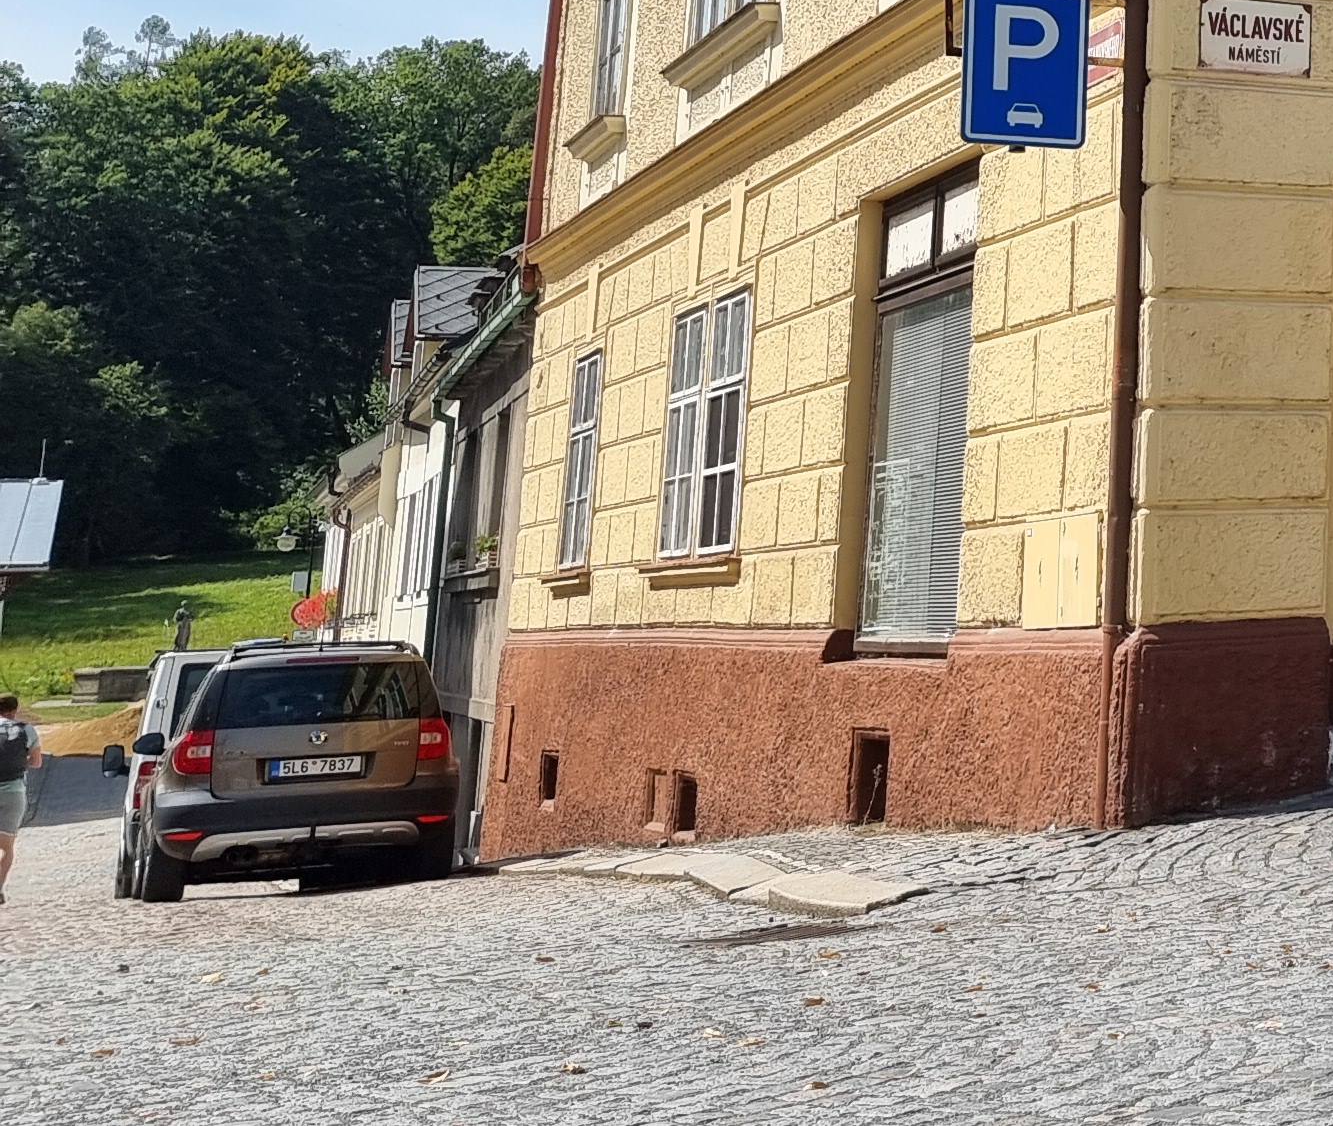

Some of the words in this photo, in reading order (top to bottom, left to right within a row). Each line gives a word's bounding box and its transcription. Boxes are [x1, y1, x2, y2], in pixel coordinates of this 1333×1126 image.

[1207, 6, 1305, 43] VÁCLAVSKÉ
[1228, 42, 1281, 66] NÁMĚSTÍ
[282, 760, 309, 775] 5L6
[320, 758, 355, 773] 7837
